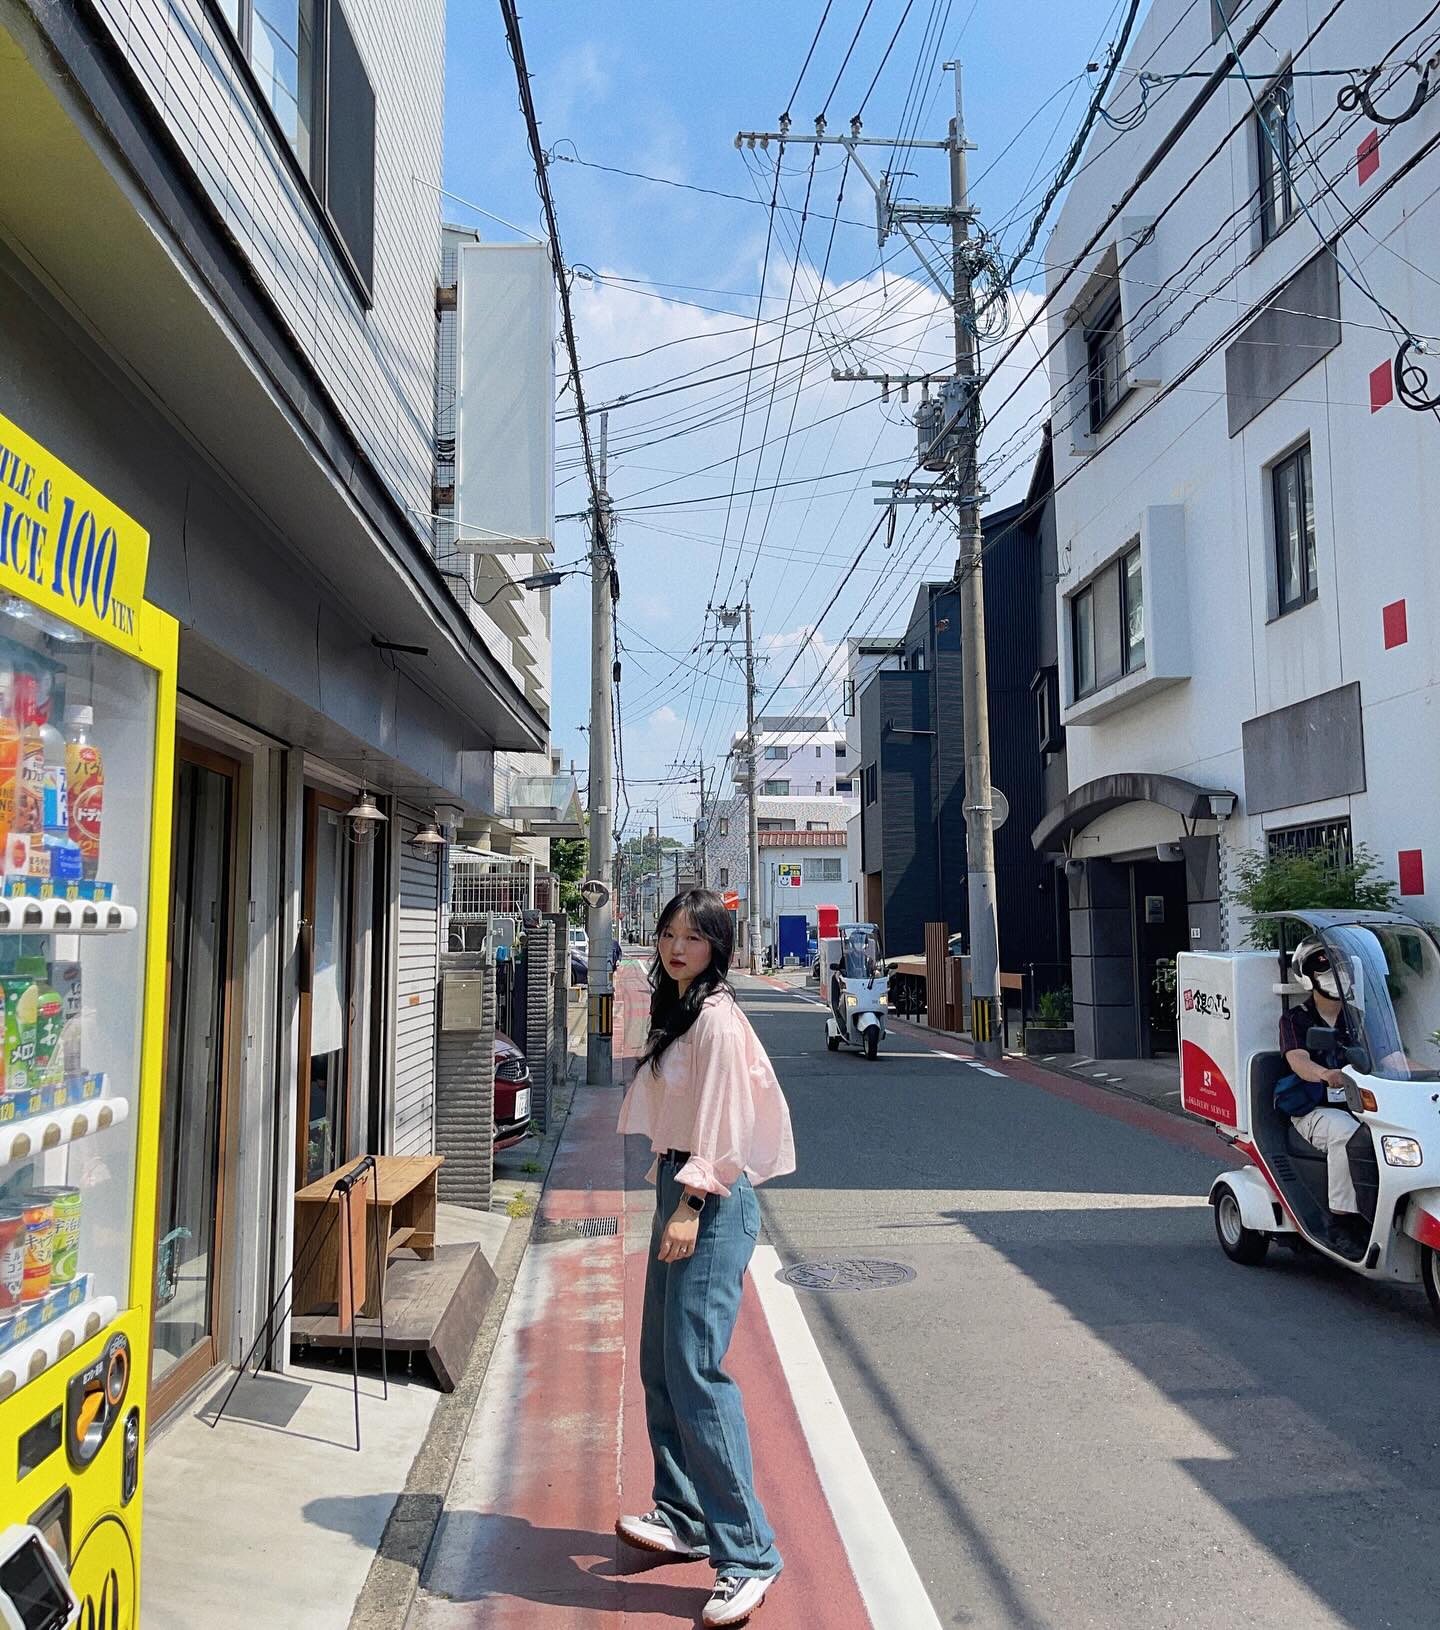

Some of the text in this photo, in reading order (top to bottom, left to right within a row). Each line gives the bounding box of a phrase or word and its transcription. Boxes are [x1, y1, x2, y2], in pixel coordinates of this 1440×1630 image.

[37, 479, 53, 514] &
[52, 496, 117, 621] 100
[112, 598, 135, 636] YEN
